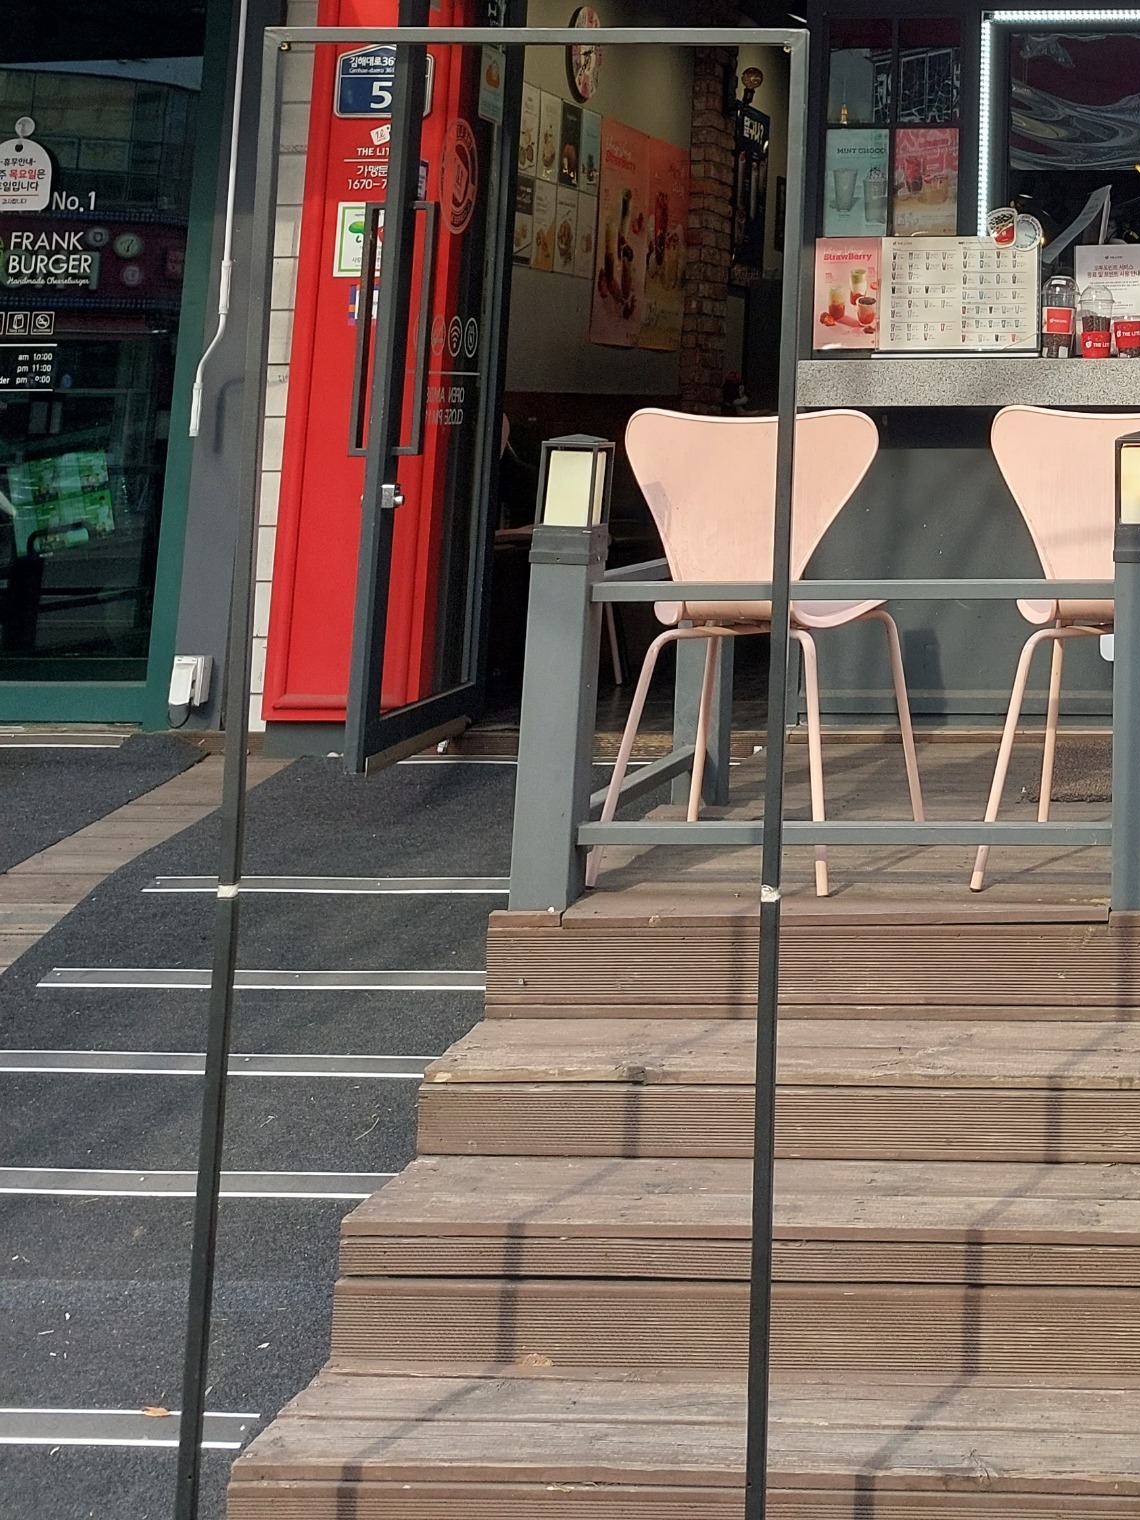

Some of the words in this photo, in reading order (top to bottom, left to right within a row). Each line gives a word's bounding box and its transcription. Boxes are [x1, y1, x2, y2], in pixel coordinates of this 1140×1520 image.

[349, 56, 396, 68] 김해대로36
[370, 81, 393, 109] 5
[356, 147, 374, 156] THE
[376, 147, 390, 156] LIT
[9, 168, 46, 180] 목요일은
[356, 165, 388, 177] 가맹문
[347, 179, 388, 190] 1670-7
[52, 191, 96, 212] No.1
[10, 231, 84, 251] FRANK
[823, 253, 872, 261] StrawBerry
[8, 254, 92, 274] BURGER
[6, 276, 46, 285] Handmade
[46, 276, 90, 287] Cheeseburger
[33, 352, 53, 361] 10:00
[16, 365, 29, 374] pm
[32, 364, 52, 372] 11:00
[16, 376, 28, 385] pm
